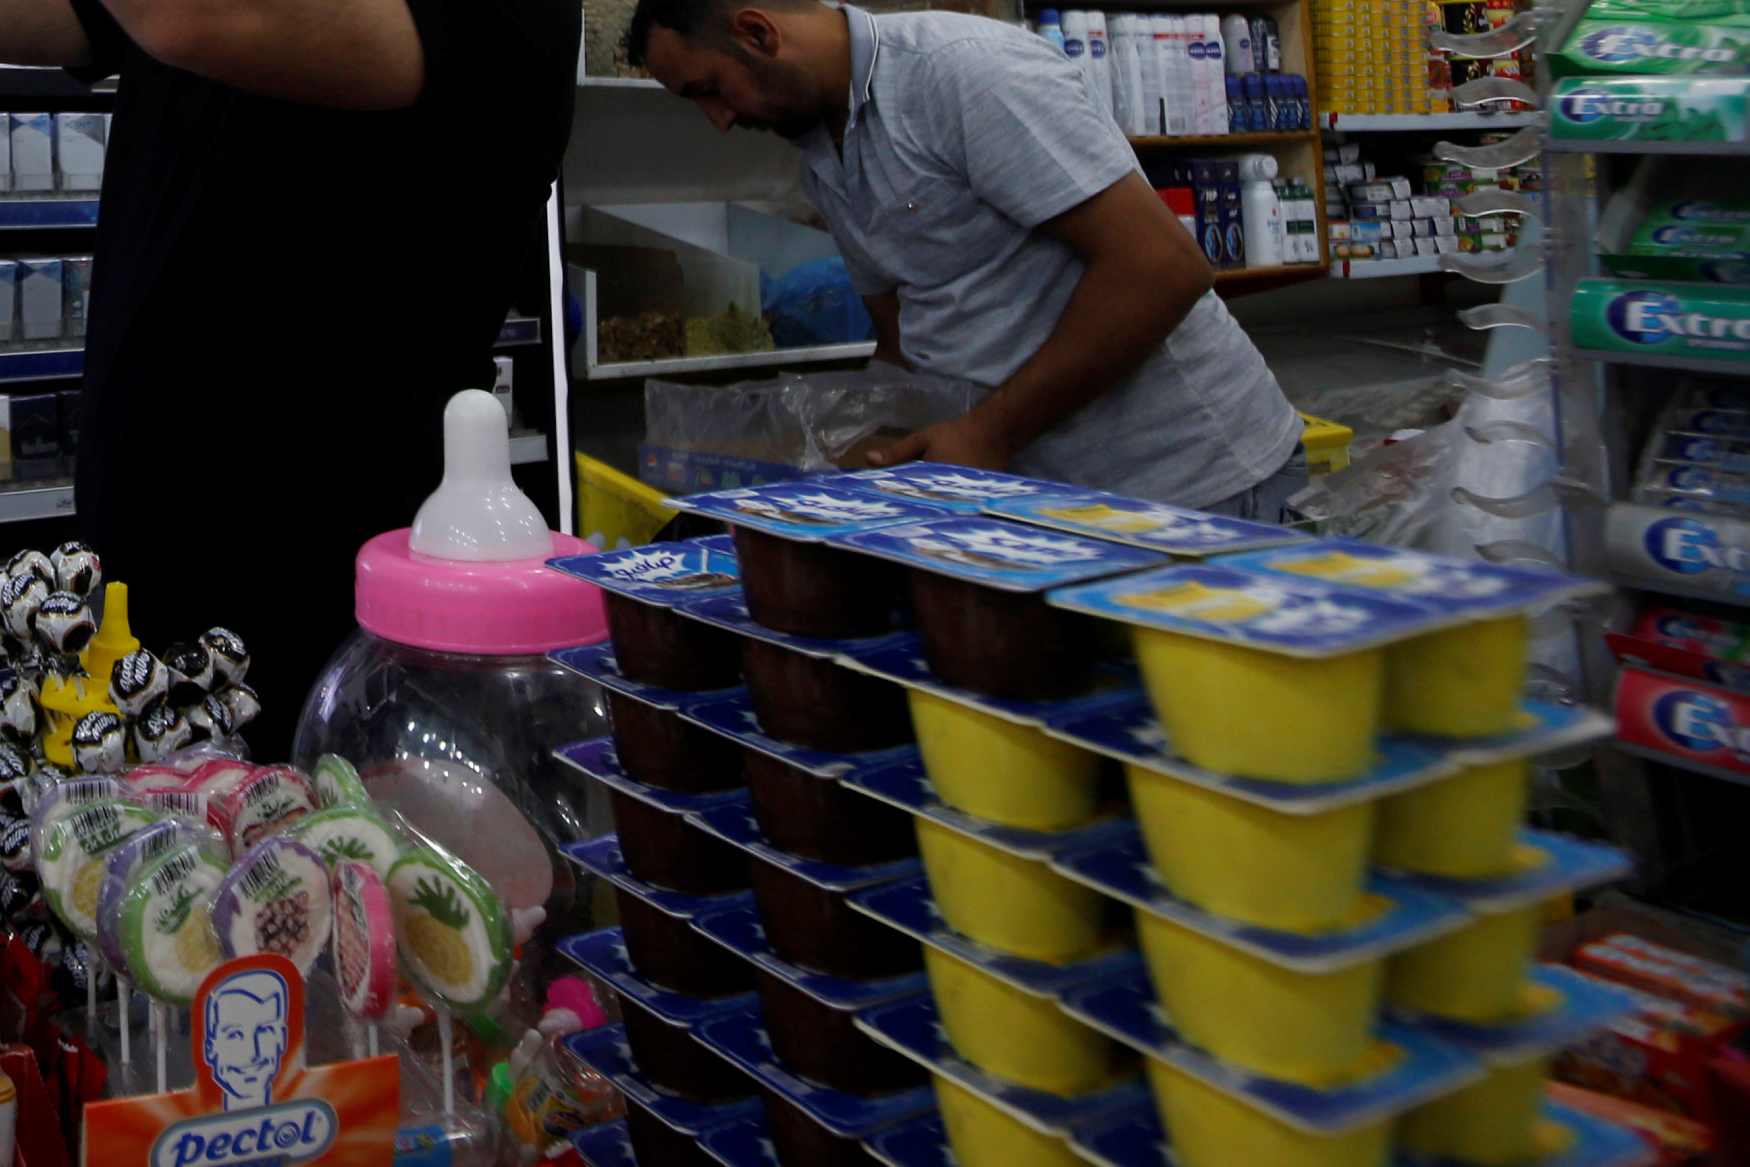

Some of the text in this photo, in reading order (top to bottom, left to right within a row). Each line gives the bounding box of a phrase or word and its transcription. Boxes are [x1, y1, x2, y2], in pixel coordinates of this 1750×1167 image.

[1600, 29, 1737, 63] Extra
[1572, 92, 1664, 117] Extra
[92, 714, 118, 741] Milky
